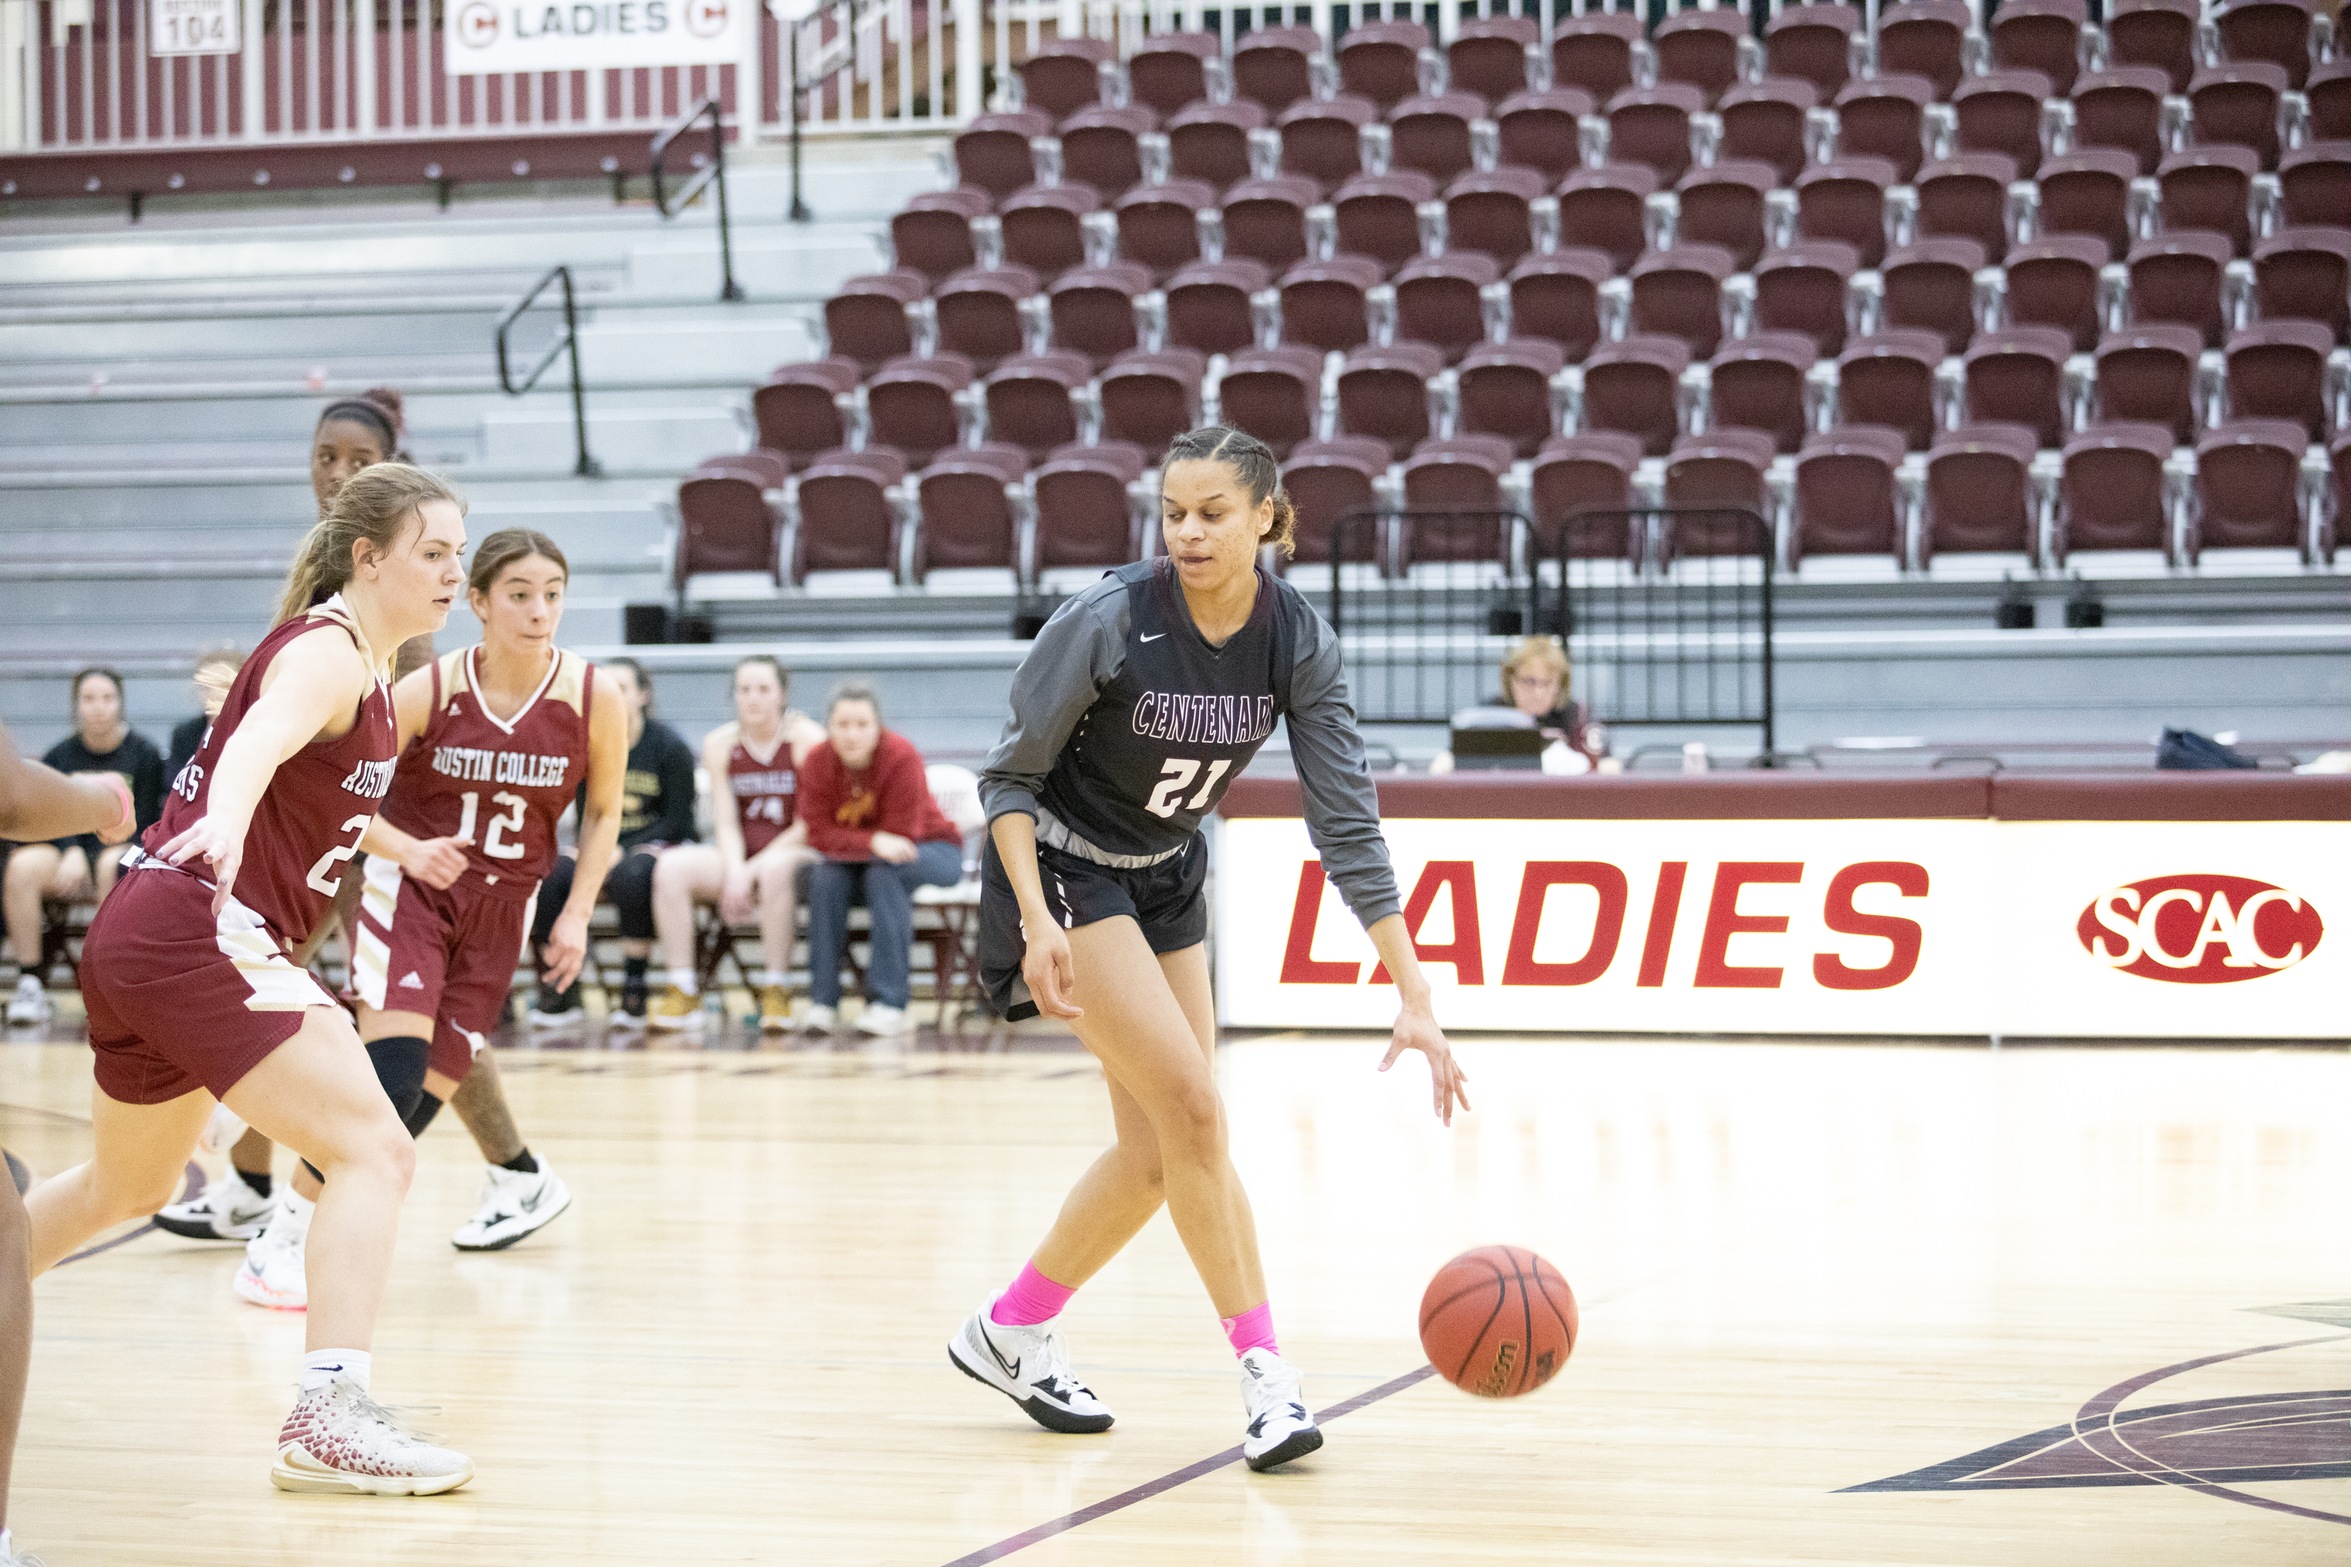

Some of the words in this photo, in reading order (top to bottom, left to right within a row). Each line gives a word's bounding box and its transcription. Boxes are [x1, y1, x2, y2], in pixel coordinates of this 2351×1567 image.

[167, 16, 224, 46] 104
[514, 1, 669, 38] LADIES
[1132, 691, 1274, 744] CENTENAR
[432, 747, 494, 782] AUSTIN
[496, 752, 569, 787] COLLEGE
[1144, 758, 1232, 819] 21
[460, 790, 528, 859] 12
[1279, 861, 1930, 990] LADIES
[2093, 888, 2303, 970] SCAC
